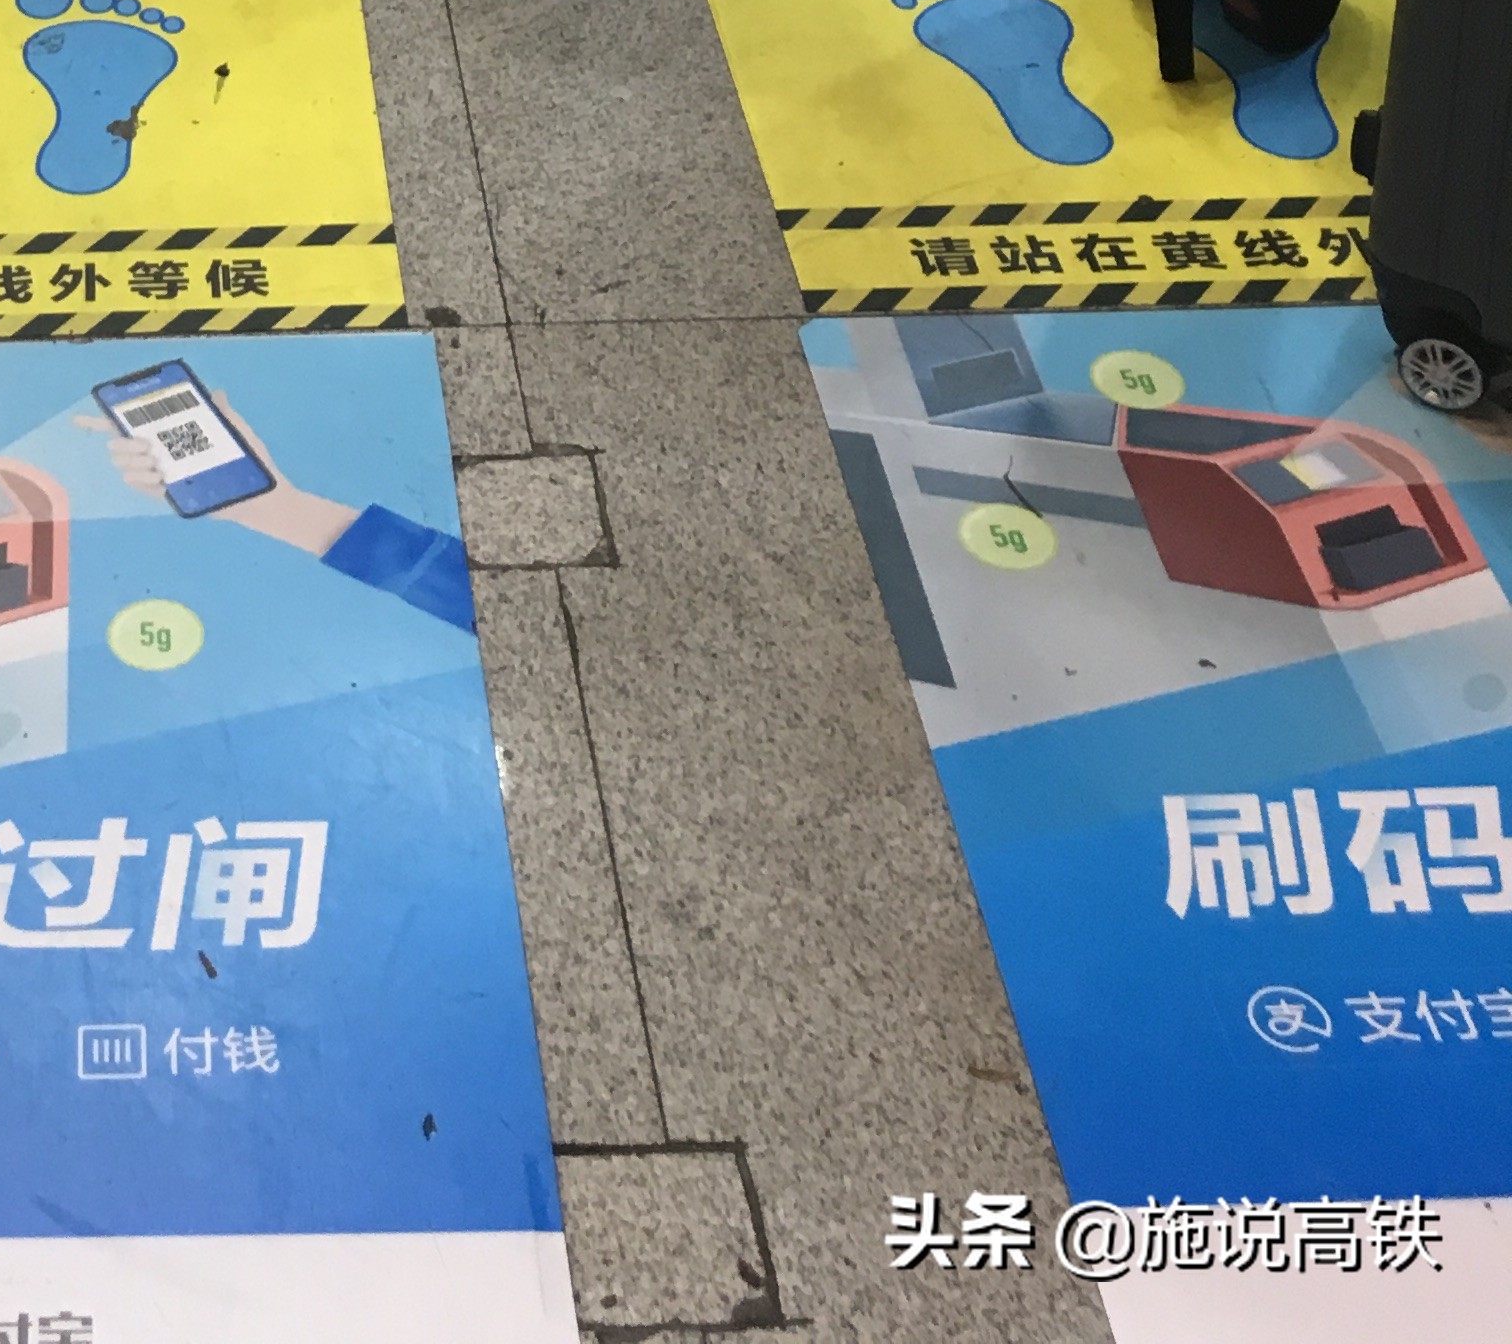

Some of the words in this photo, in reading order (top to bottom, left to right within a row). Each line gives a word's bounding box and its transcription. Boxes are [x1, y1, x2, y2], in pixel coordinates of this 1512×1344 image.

[1119, 368, 1155, 395] 5g
[989, 523, 1028, 554] 5g
[138, 619, 172, 652] 5g
[1160, 785, 1512, 920] 刷码
[163, 1025, 282, 1078] 付钱
